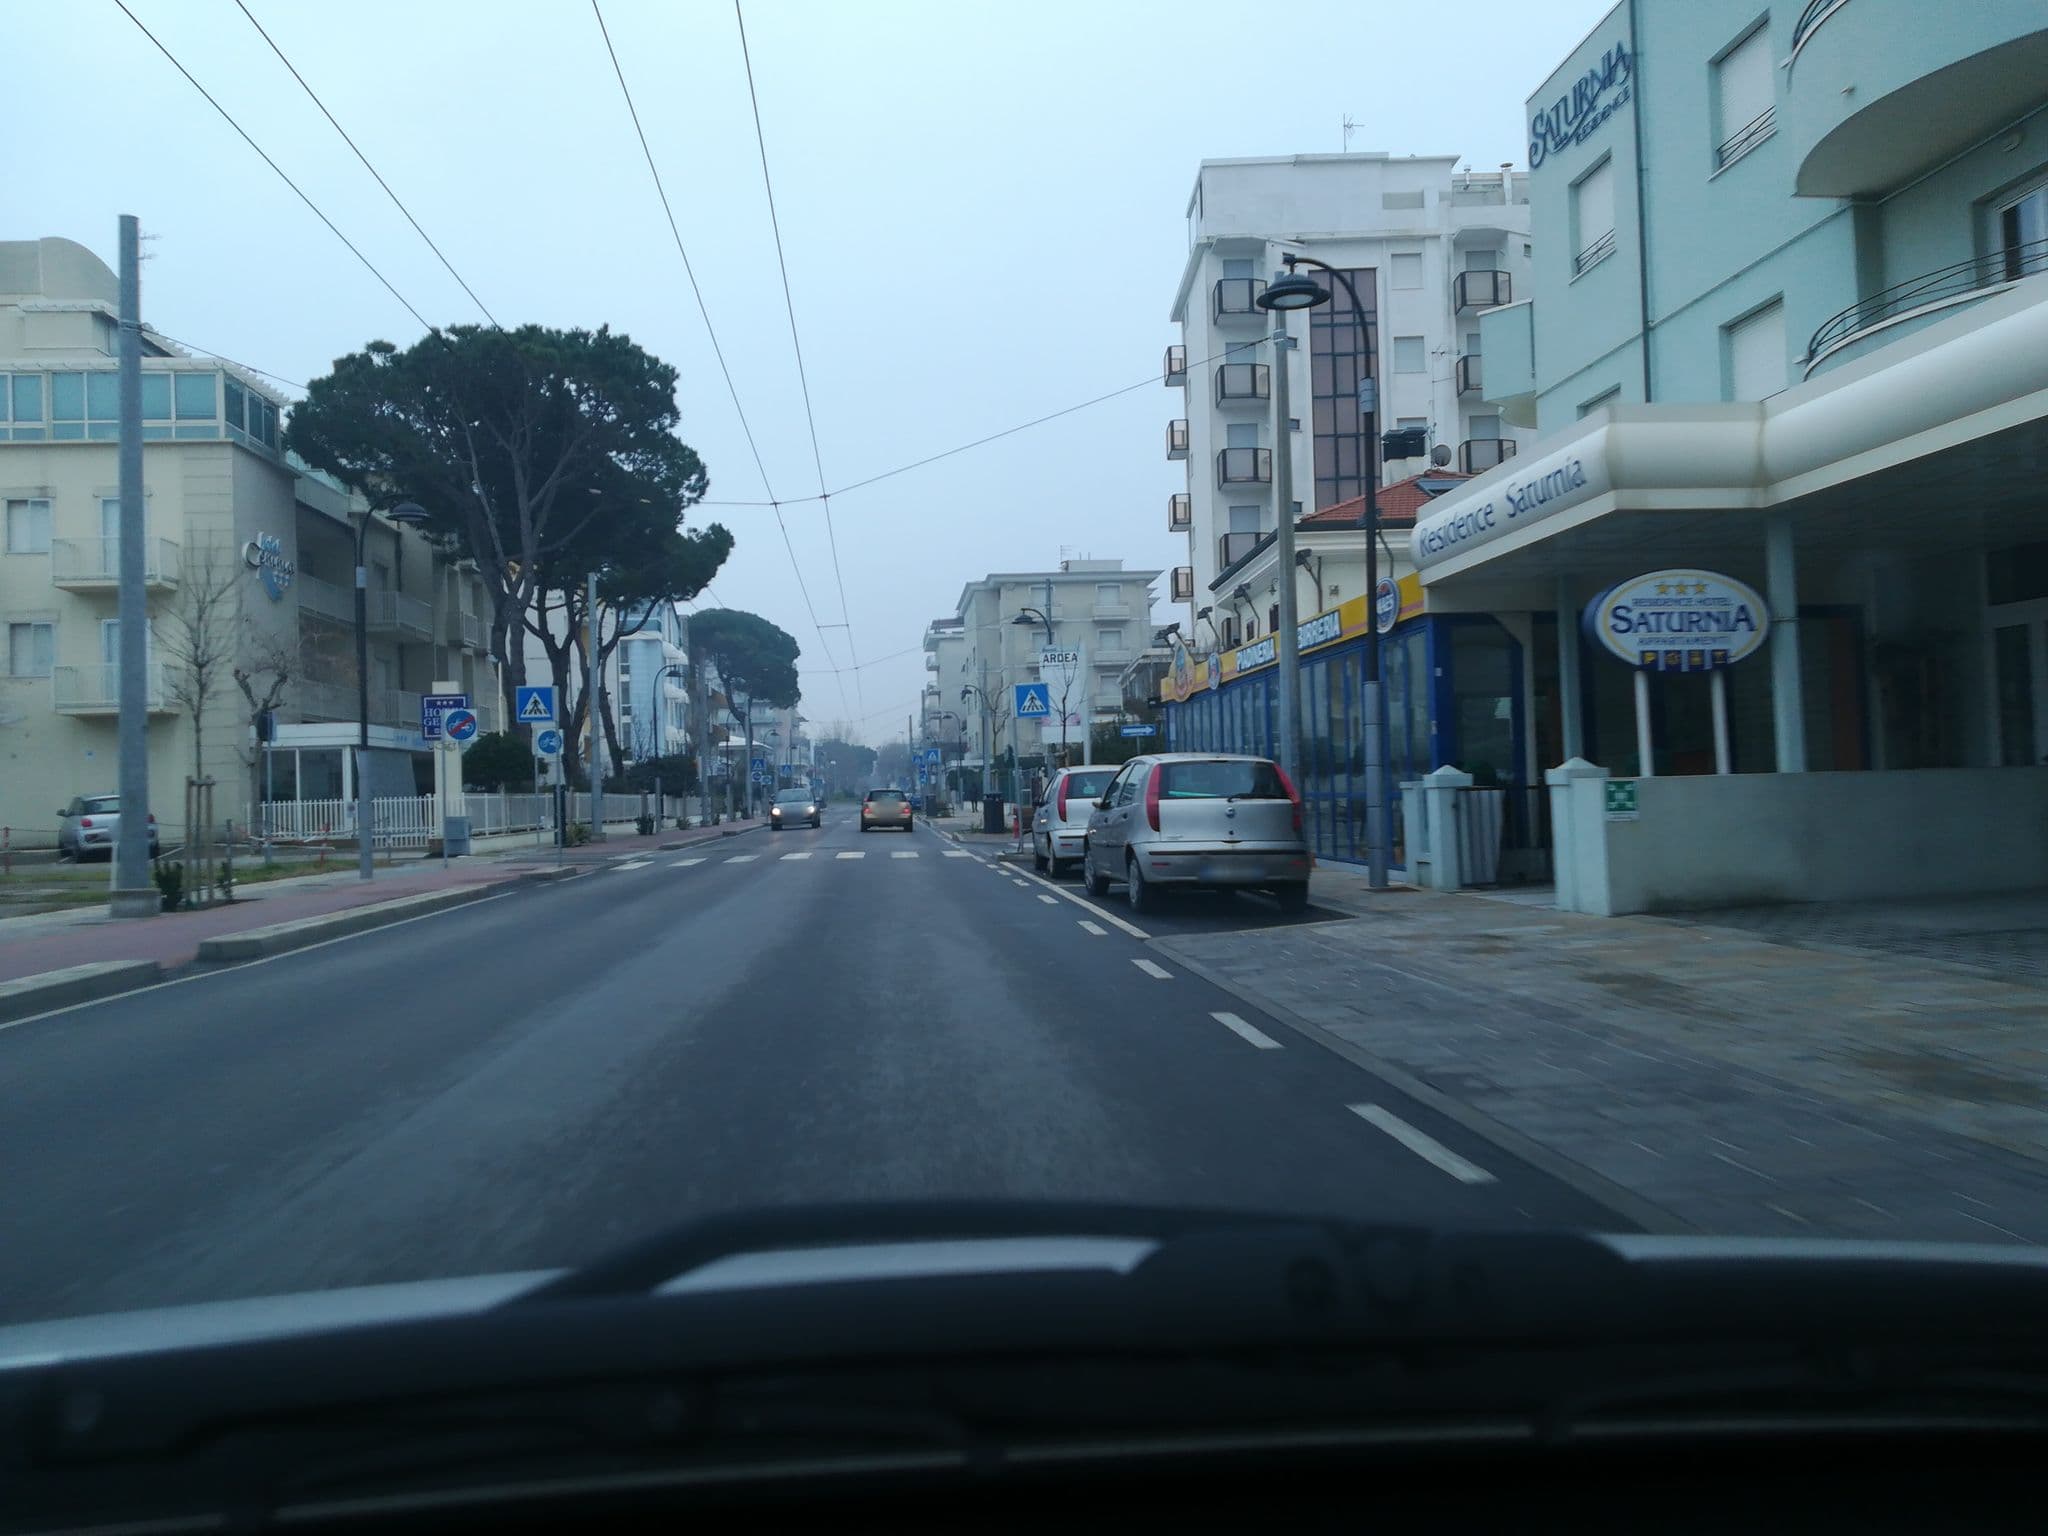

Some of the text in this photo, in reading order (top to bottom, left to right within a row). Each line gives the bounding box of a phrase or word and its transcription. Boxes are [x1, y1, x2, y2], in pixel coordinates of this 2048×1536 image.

[1529, 42, 1631, 169] SATURNIA
[1419, 456, 1588, 557] Residence Saturnia
[1610, 604, 1757, 634] SATURNIA
[1043, 652, 1078, 663] ARDEA
